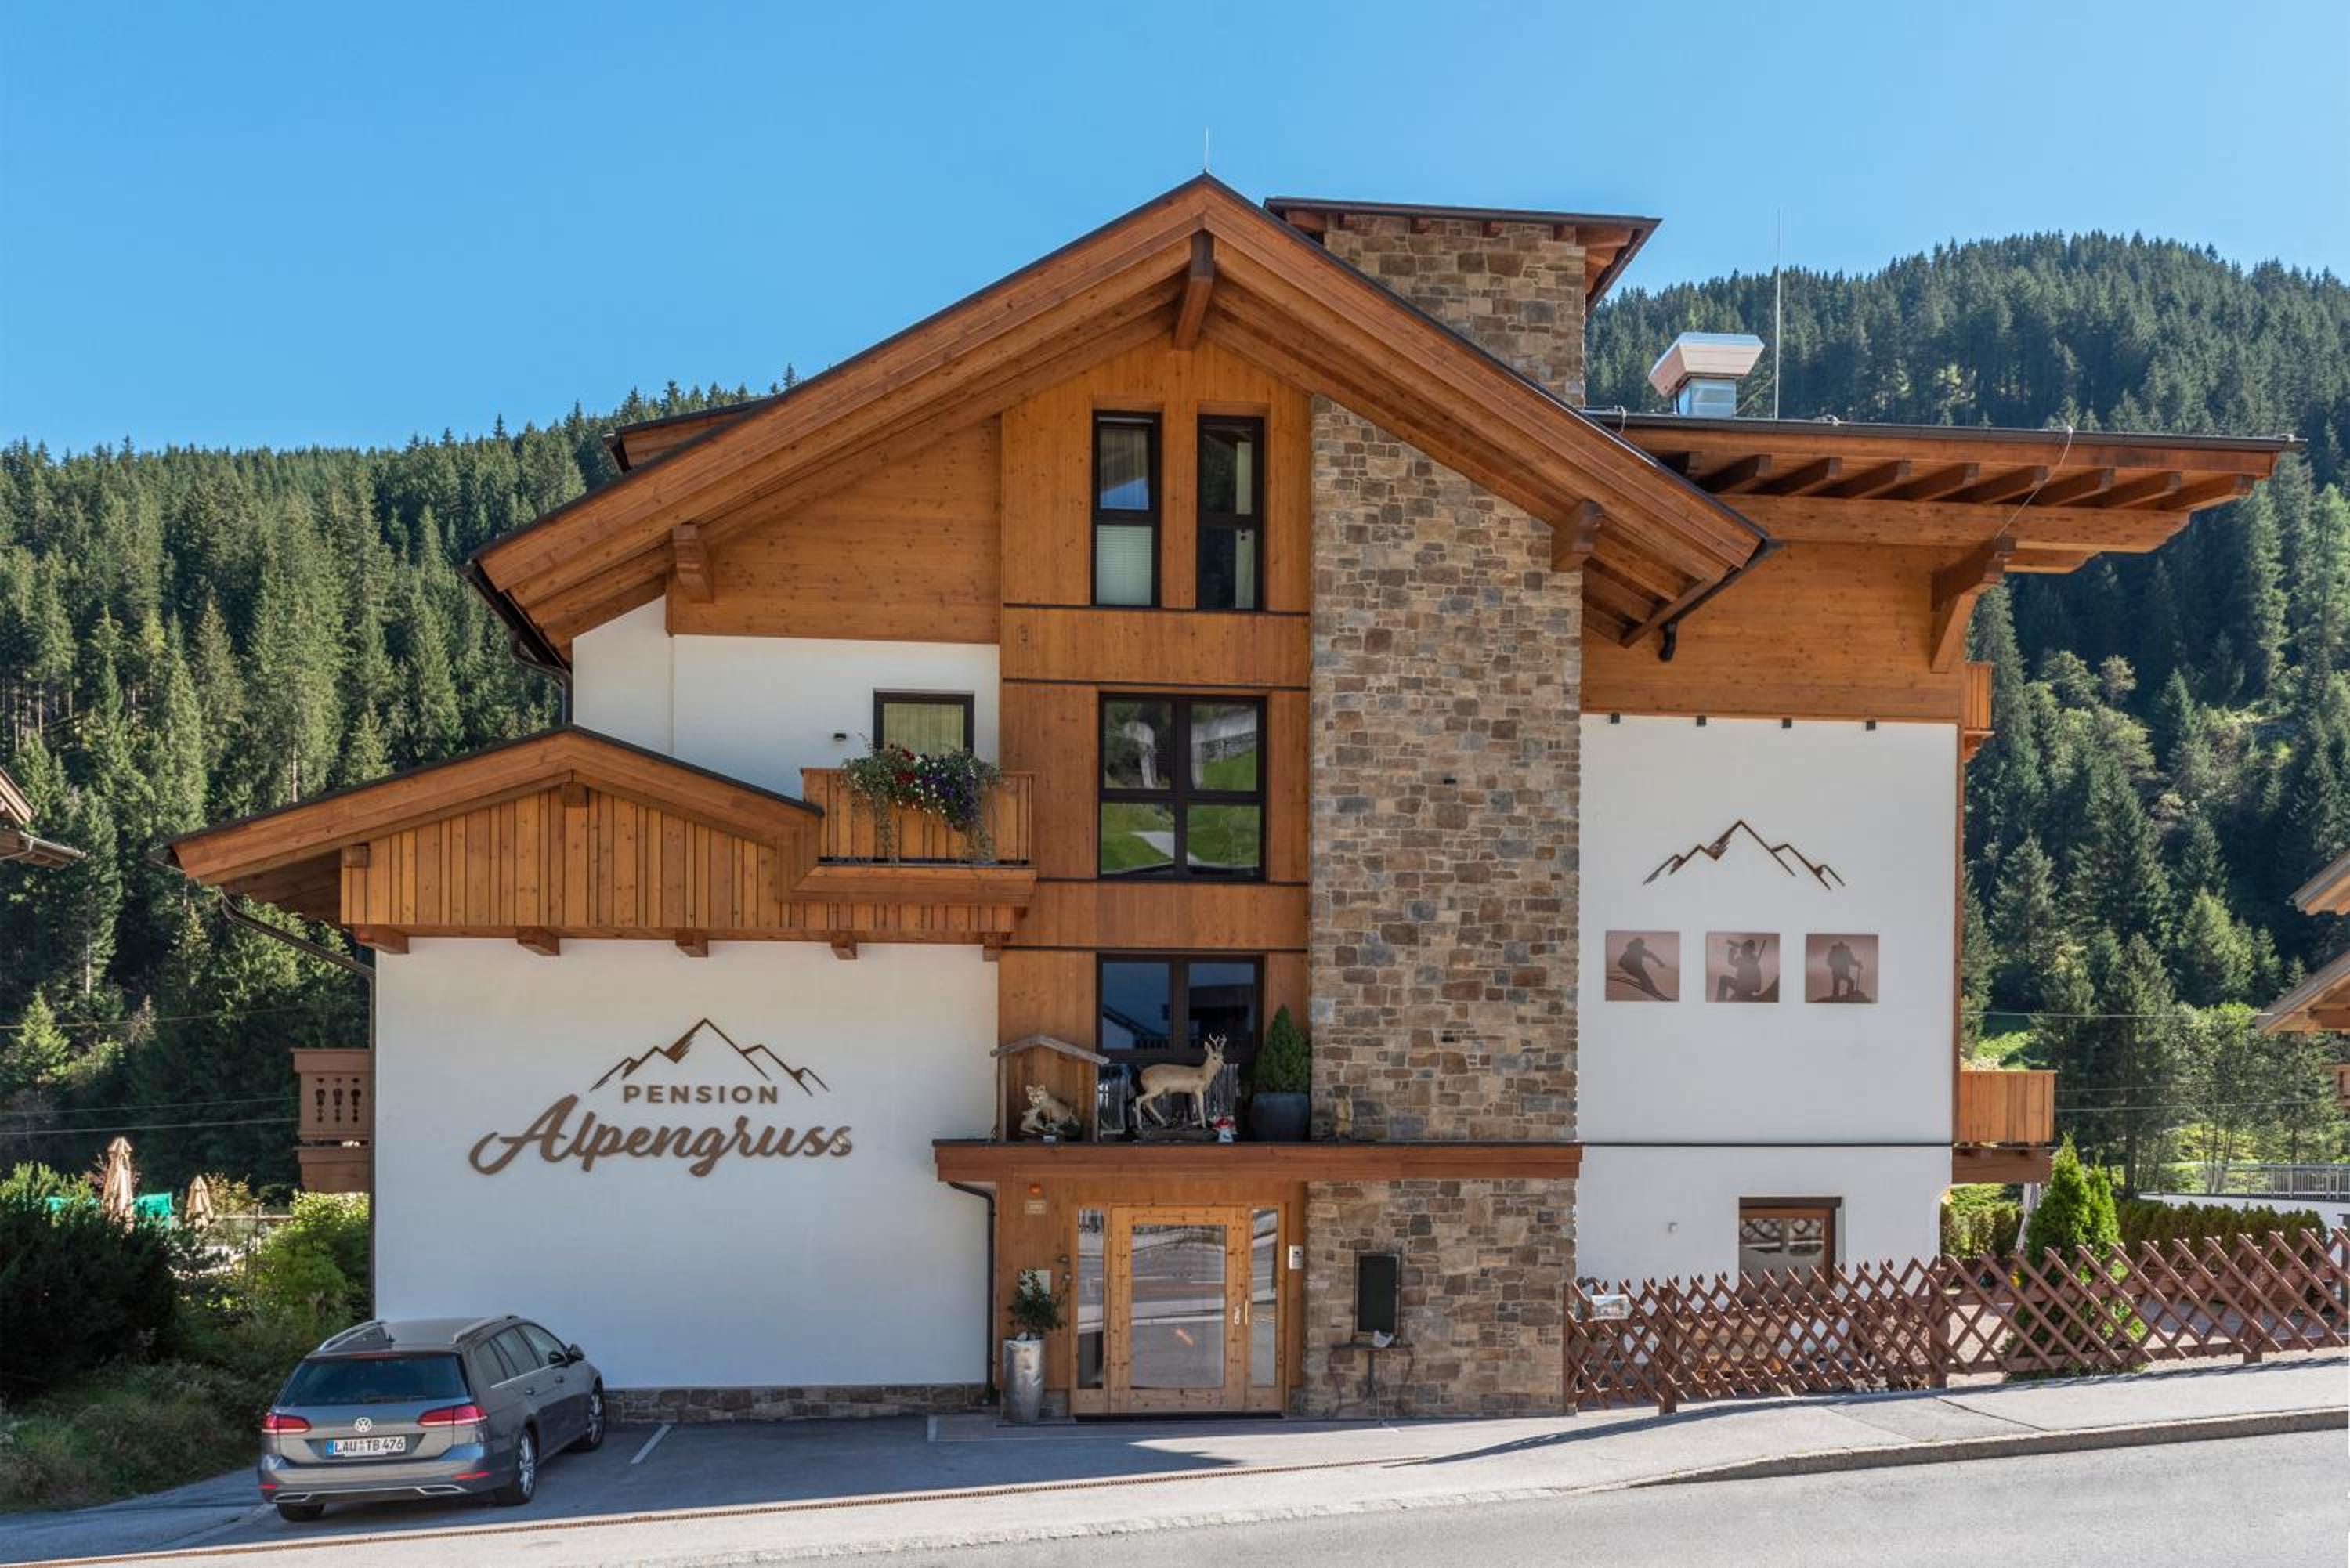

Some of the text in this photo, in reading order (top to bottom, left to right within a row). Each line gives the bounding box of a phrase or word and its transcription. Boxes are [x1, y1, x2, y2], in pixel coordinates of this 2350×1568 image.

[624, 1085, 778, 1104] PENSION
[468, 1093, 853, 1177] Alpengruss
[334, 1438, 403, 1453] LAU TB 476
